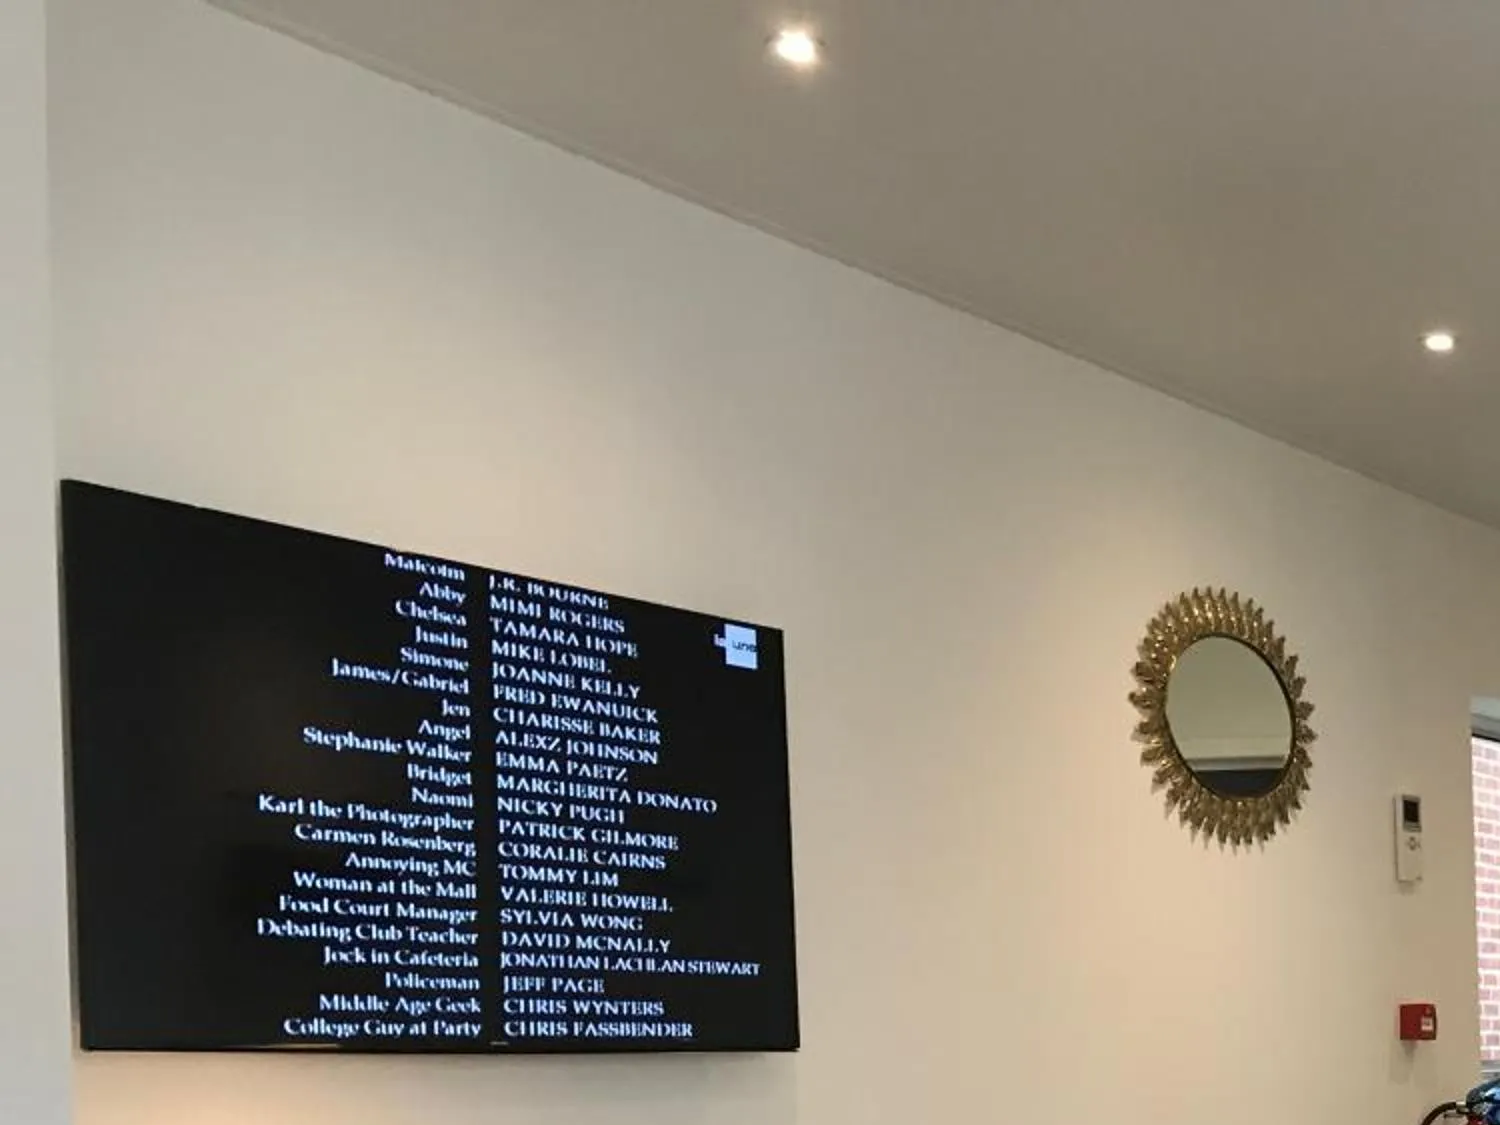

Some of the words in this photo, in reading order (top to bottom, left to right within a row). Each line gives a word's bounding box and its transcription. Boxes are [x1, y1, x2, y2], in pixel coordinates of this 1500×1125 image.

[384, 553, 465, 581] Malcolm
[420, 581, 466, 607] Abby
[490, 594, 541, 618] MIMI
[550, 606, 625, 633] ROGERS
[395, 600, 467, 626] Chelsea
[489, 617, 579, 647] TAMARA
[585, 635, 638, 659] HOPE
[415, 625, 468, 649] Justin
[492, 639, 545, 663] MIKE
[332, 657, 469, 694] James/Gabriel
[493, 684, 545, 704] FRED
[400, 647, 469, 671] Simone
[492, 661, 575, 689] JOANNE
[581, 676, 640, 699] KELLY
[418, 719, 471, 741] Angel
[566, 738, 658, 765] JOHNSON
[442, 698, 471, 717] Jen
[493, 707, 594, 735] CHARISSE
[600, 721, 661, 745] BAKER
[303, 726, 402, 753] Stephanie
[405, 739, 472, 762] Walker
[496, 751, 560, 774] EMMA
[407, 763, 472, 787] Bridget
[496, 773, 631, 803] MARGHERITA
[637, 791, 717, 814] DONATO
[411, 787, 474, 809] Naomi
[497, 796, 563, 817] NICKY
[569, 804, 625, 825] PUGH
[258, 794, 304, 815] Karl
[310, 800, 343, 817] the
[347, 803, 475, 832] Photographer
[499, 819, 586, 842] PATRICK
[591, 828, 679, 850] GILMORE
[294, 823, 376, 845] Carmen
[381, 830, 476, 857] Rosenberg
[498, 841, 588, 864] CORALIE
[593, 852, 666, 870] CAIRNS
[345, 852, 439, 877] Annoying
[443, 859, 476, 877] MC
[498, 863, 577, 884] TOMMY
[583, 869, 619, 887] LIM
[293, 871, 373, 892] Woman
[377, 879, 395, 894] at
[401, 879, 431, 897] the
[436, 881, 477, 900] Mall
[501, 886, 587, 906] VALERIE
[593, 892, 673, 912] HOWELL
[257, 918, 352, 943] Debating
[355, 923, 403, 941] Club
[405, 926, 479, 945] Teacher
[502, 931, 570, 949] DAVID
[279, 895, 329, 913] Food
[333, 898, 390, 917] Court
[397, 902, 478, 924] Manager
[501, 908, 575, 927] SYLVIA
[581, 912, 644, 931] WONG
[324, 946, 367, 965] Jock
[371, 948, 390, 964] in
[394, 950, 479, 967] Cafeteria
[500, 952, 599, 971] JONATHAN
[603, 957, 685, 973] LACHLAN
[385, 972, 480, 990] Policeman
[503, 975, 545, 993] JEFF
[552, 977, 604, 993] PAGE
[319, 994, 390, 1012] Middle
[395, 997, 431, 1015] Age
[436, 997, 481, 1013] Geek
[503, 997, 567, 1015] CHRIS
[573, 1000, 664, 1016] WYNTERS
[283, 1017, 359, 1037] College
[363, 1019, 404, 1038] Guy
[409, 1020, 427, 1035] at
[433, 1019, 482, 1037] Party
[504, 1021, 569, 1037] CHRIS
